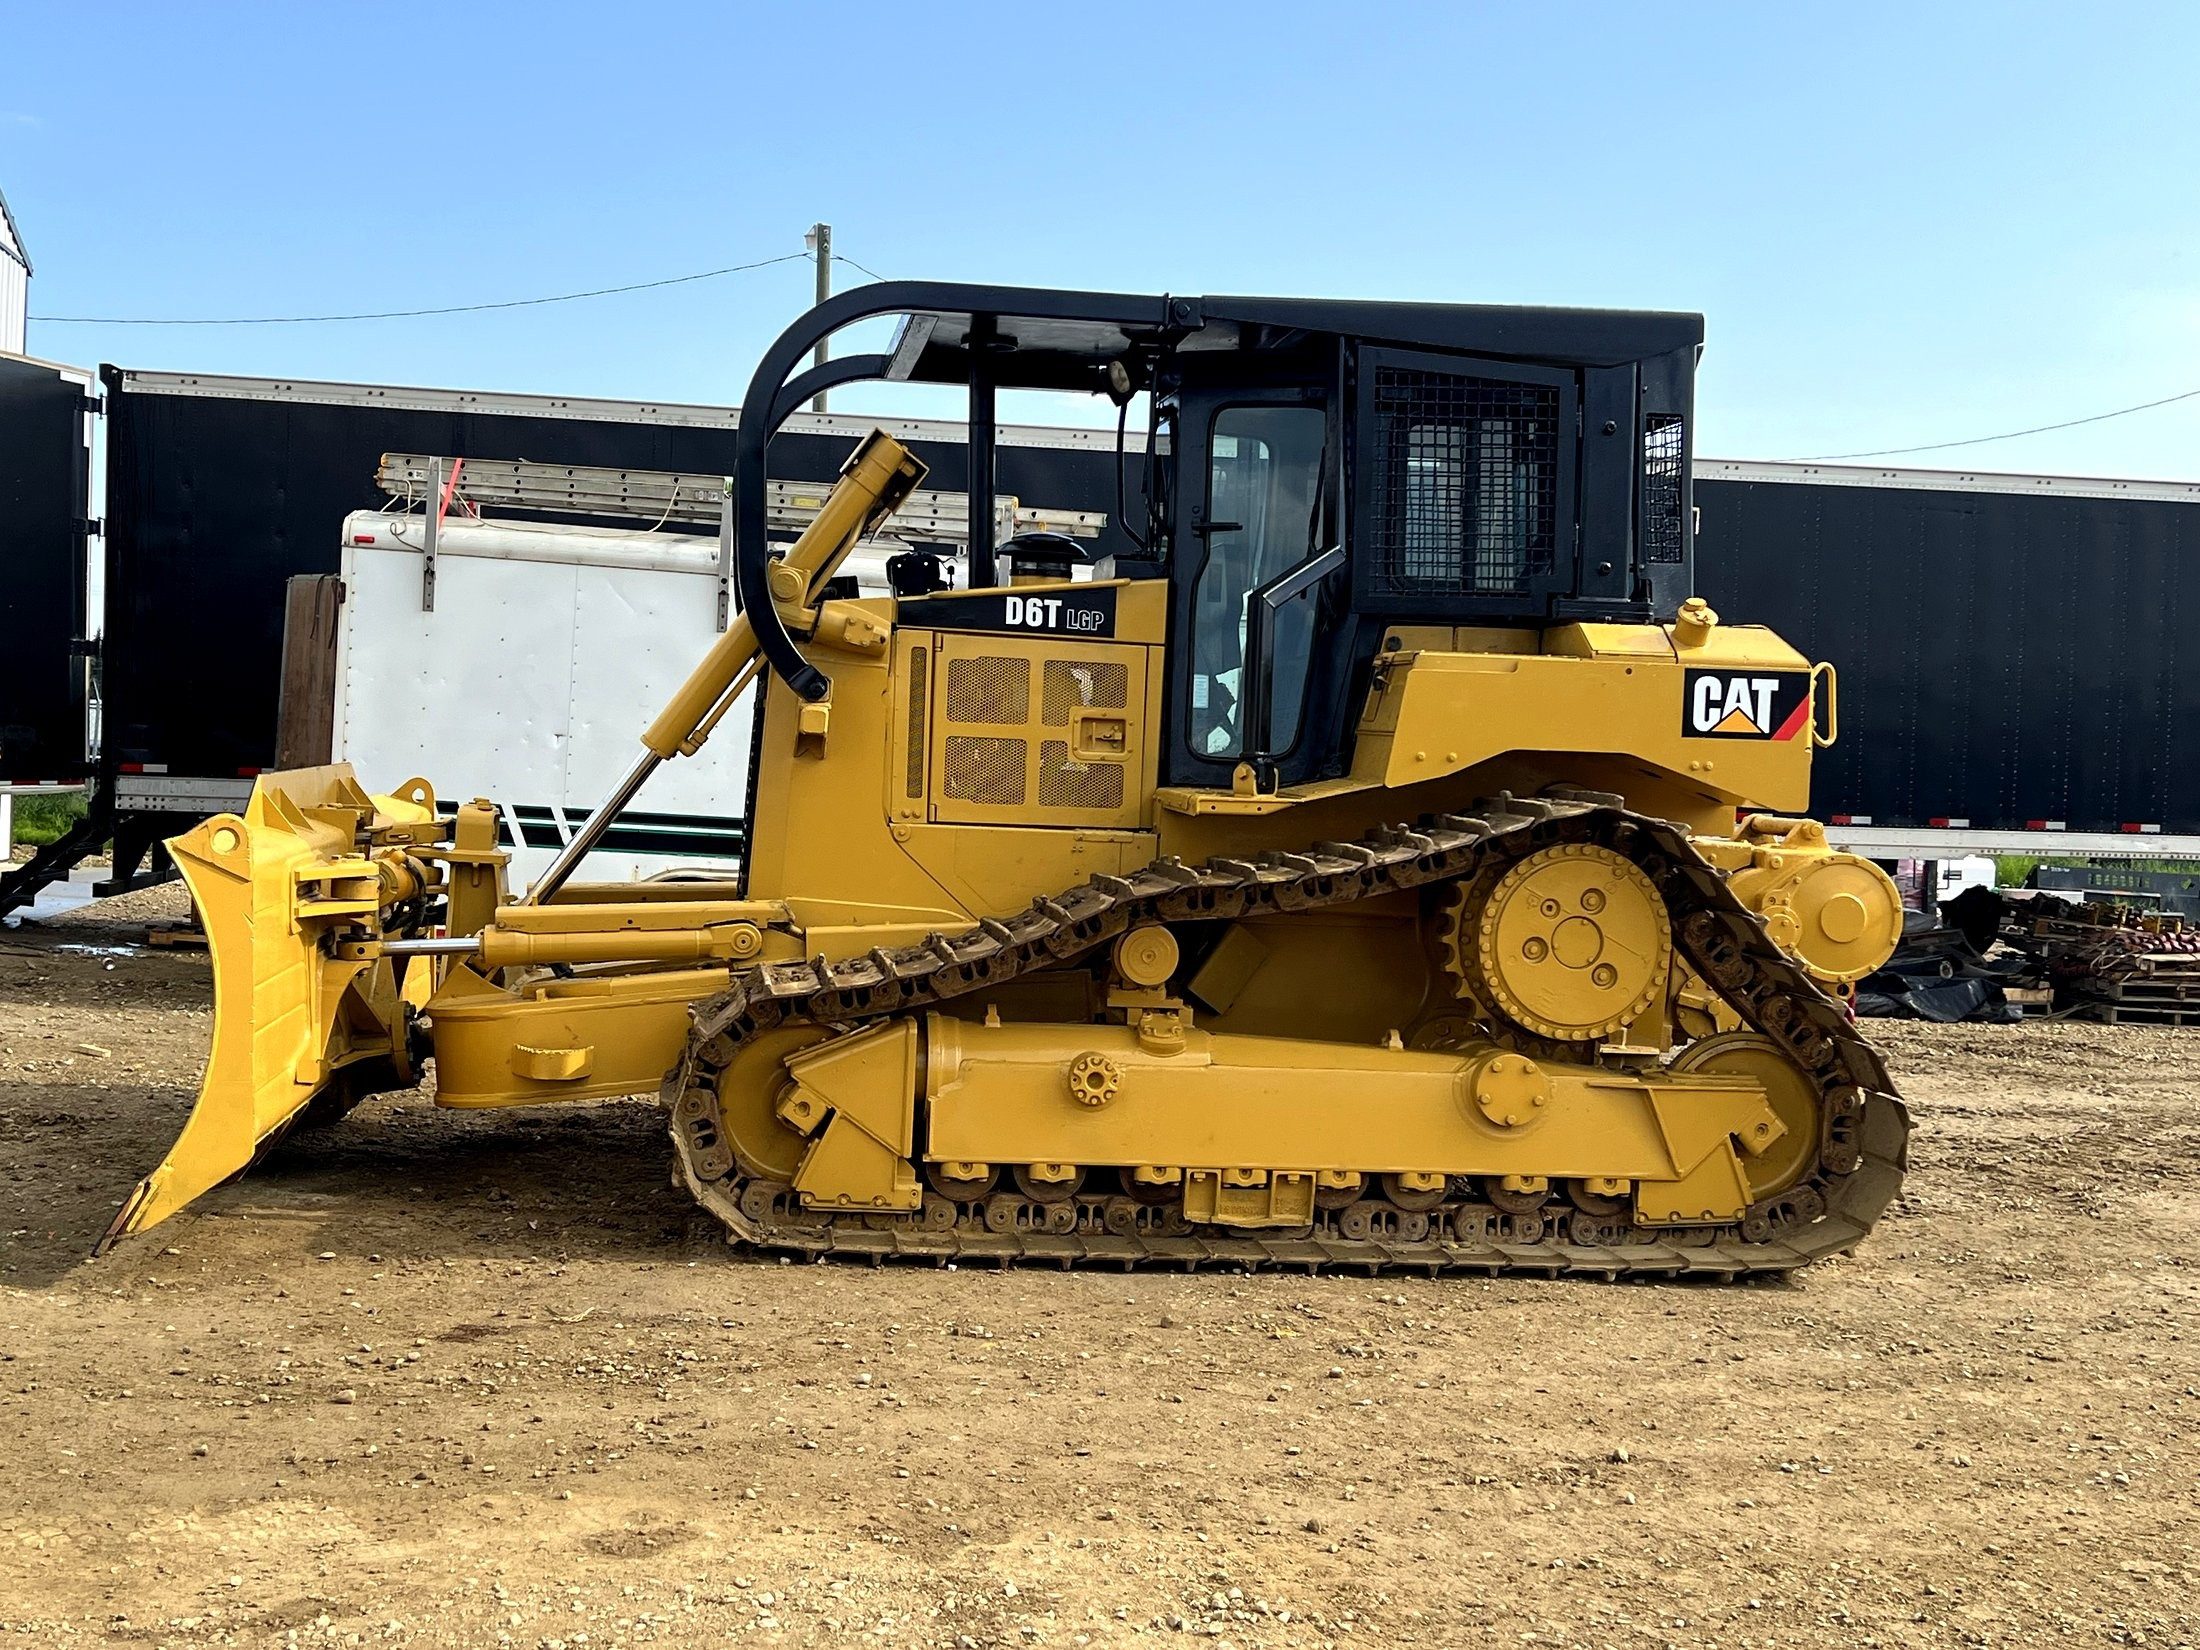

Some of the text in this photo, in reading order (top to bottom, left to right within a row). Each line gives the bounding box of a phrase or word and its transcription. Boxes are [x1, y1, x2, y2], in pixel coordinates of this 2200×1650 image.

[1005, 596, 1104, 631] D6T LGP
[1692, 675, 1779, 734] CAT
